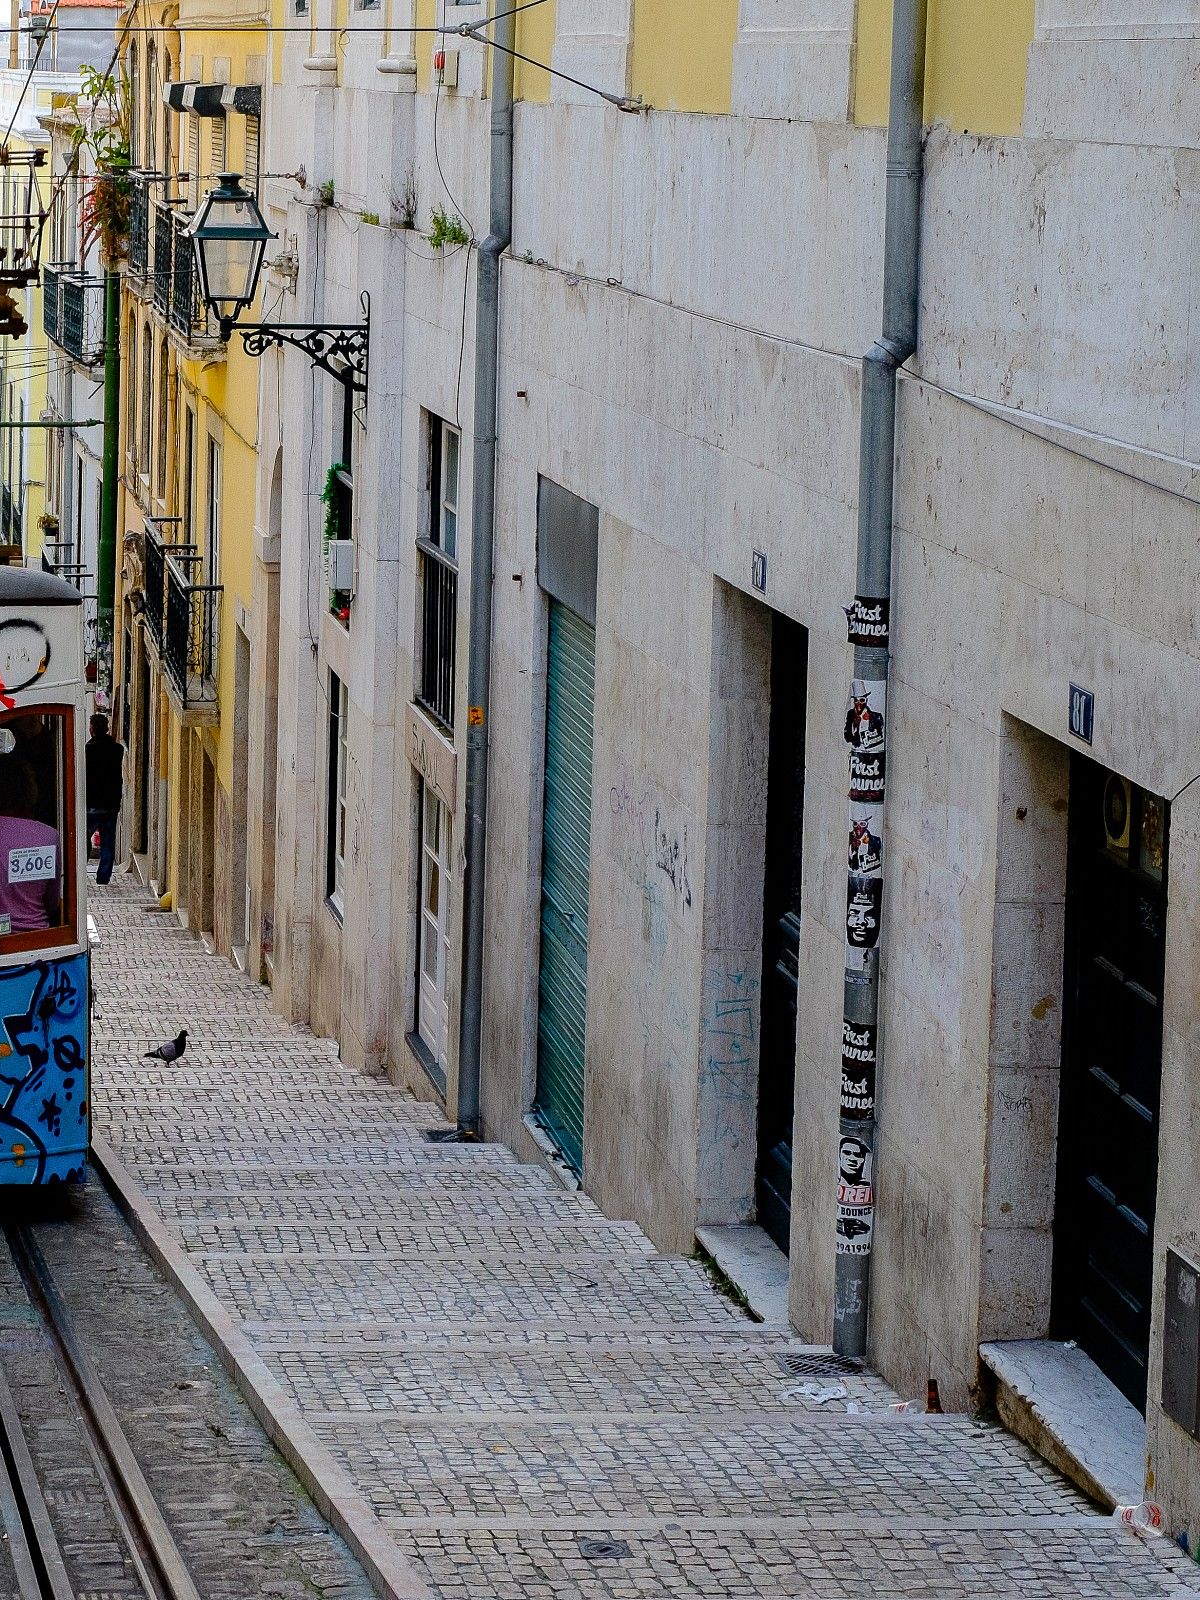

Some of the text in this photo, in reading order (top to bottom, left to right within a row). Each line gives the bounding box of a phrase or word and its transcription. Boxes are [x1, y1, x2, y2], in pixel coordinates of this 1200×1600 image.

[847, 600, 882, 621] First
[1072, 691, 1087, 736] 81
[851, 756, 880, 776] First
[850, 778, 885, 791] ounce
[843, 1022, 870, 1047] First
[842, 1043, 876, 1062] ounce.
[841, 1207, 872, 1217] BOUNCE
